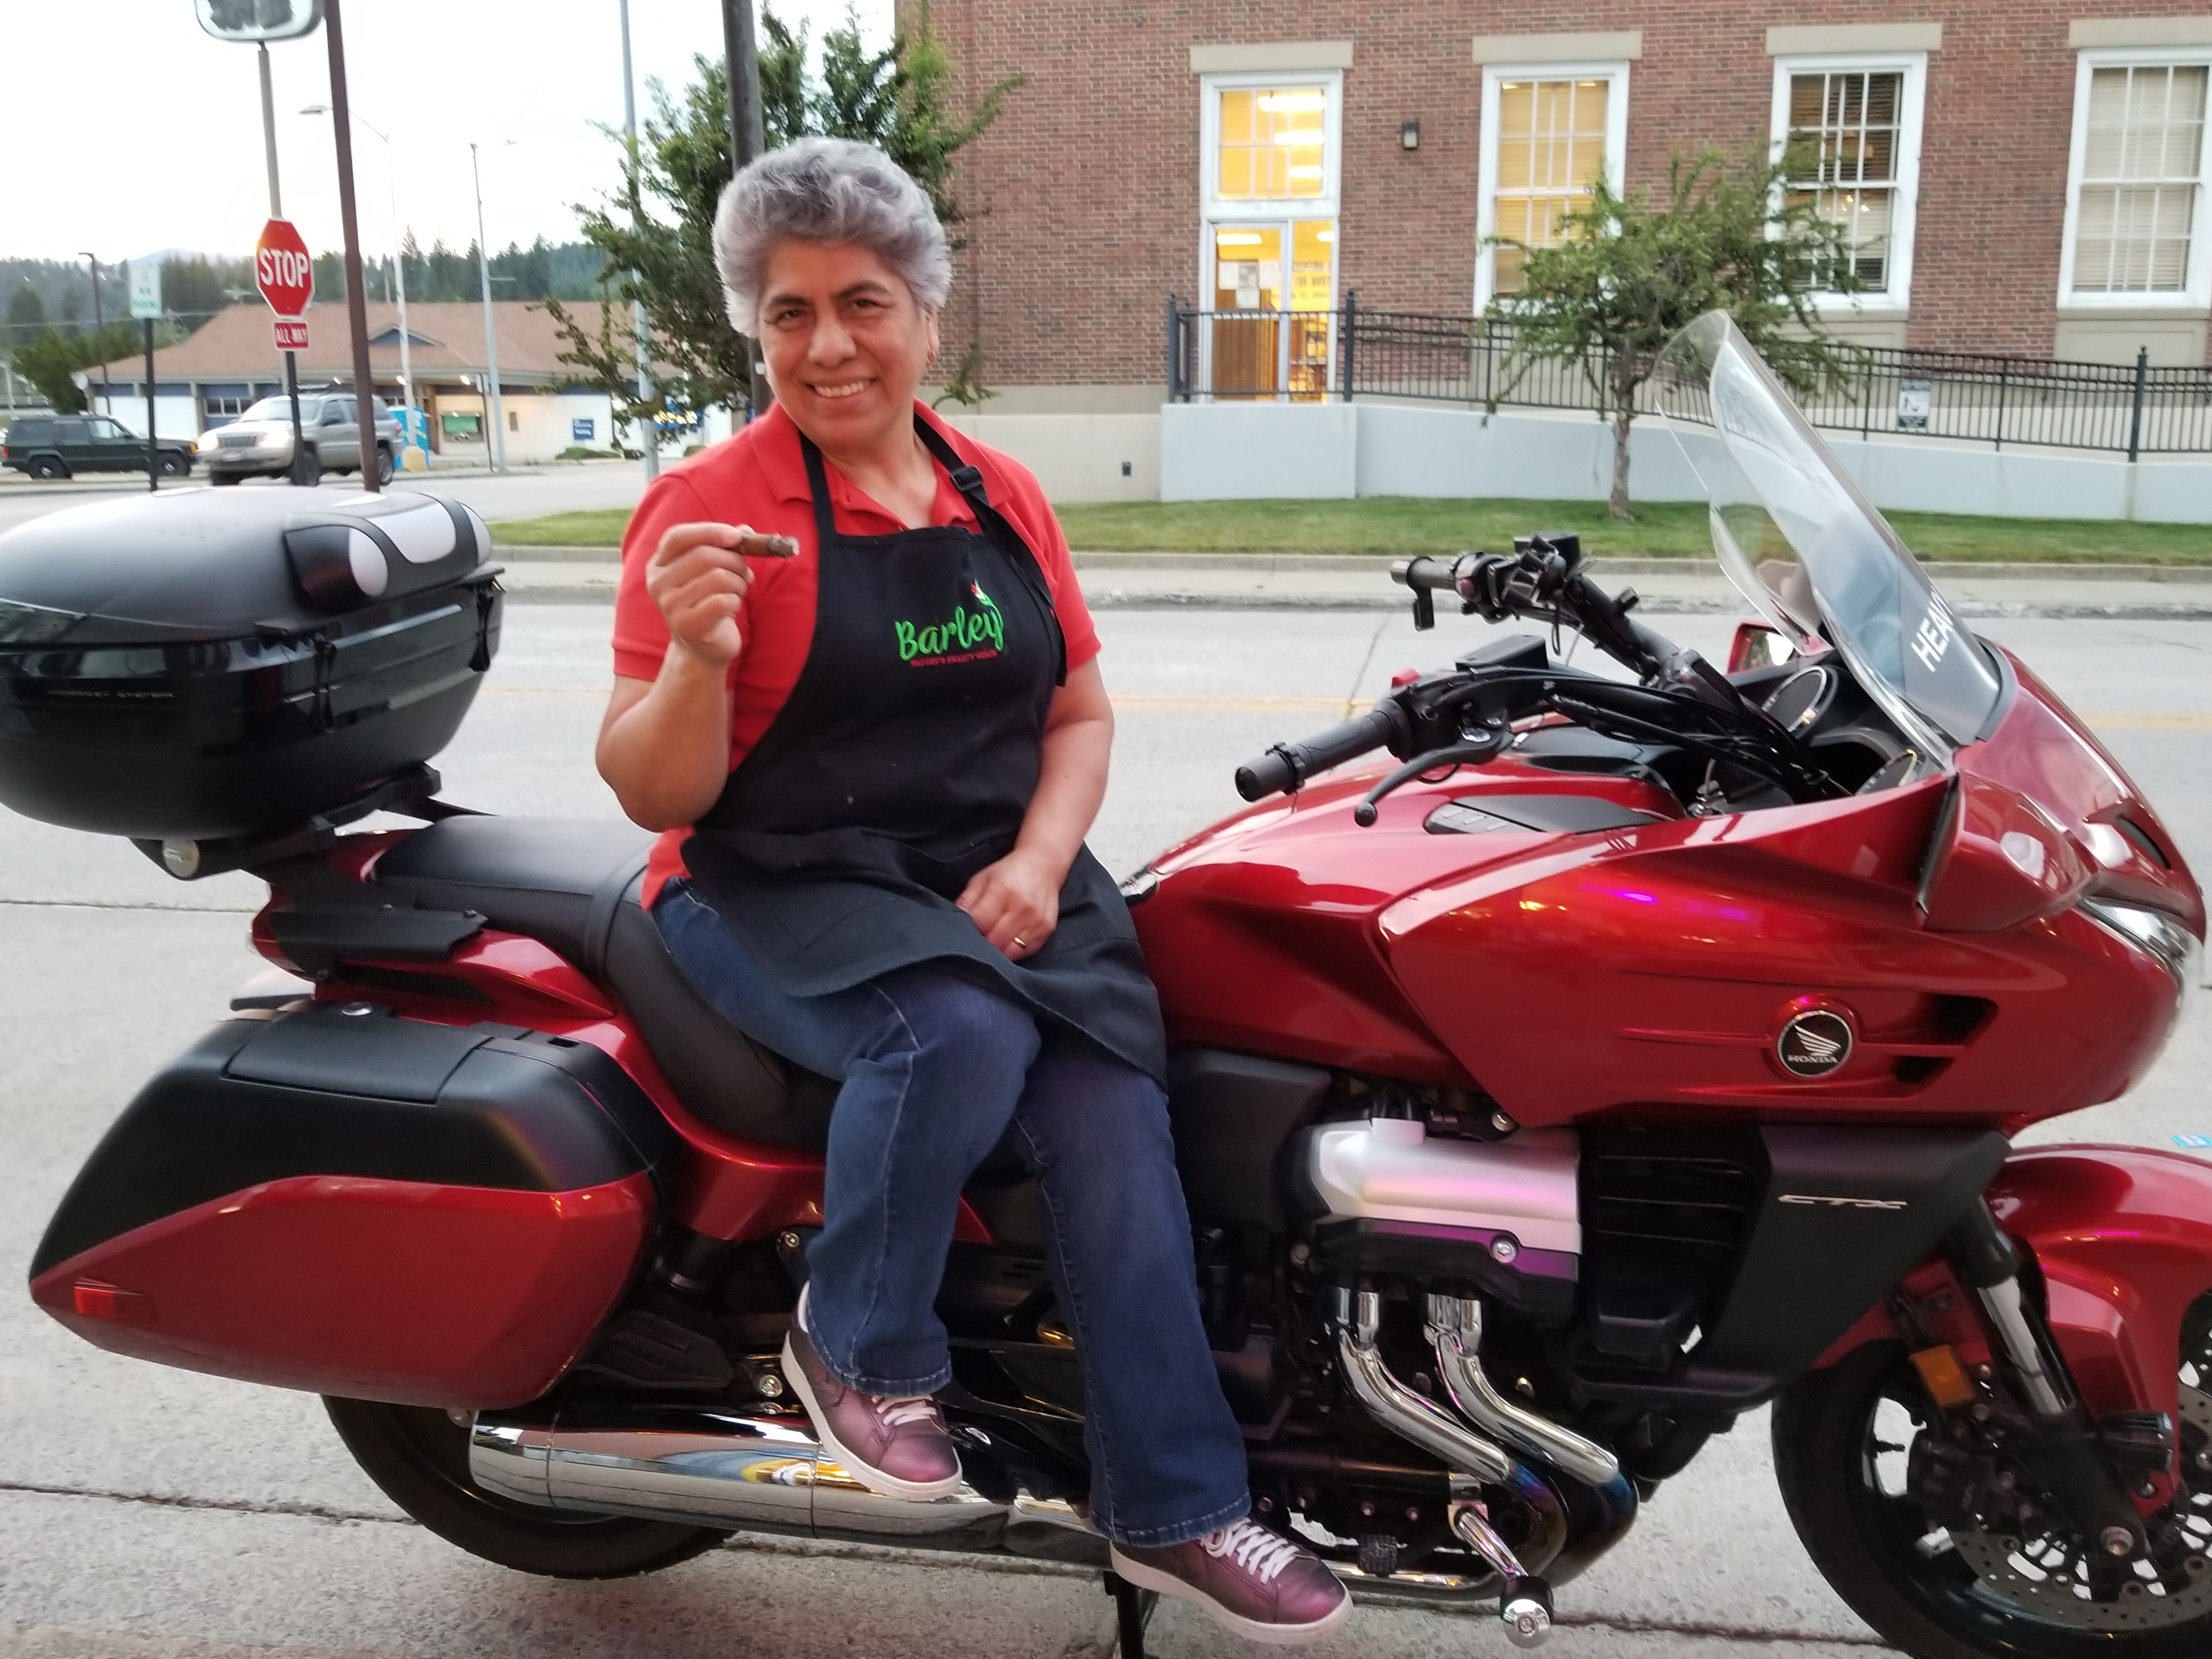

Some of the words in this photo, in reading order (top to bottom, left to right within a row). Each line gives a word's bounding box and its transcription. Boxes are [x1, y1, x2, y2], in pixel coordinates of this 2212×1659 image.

[259, 248, 309, 288] STOP
[275, 327, 291, 343] ALL
[895, 606, 1004, 661] Barley
[1787, 1054, 1838, 1063] HONDA
[1778, 1194, 1908, 1209] CTX
